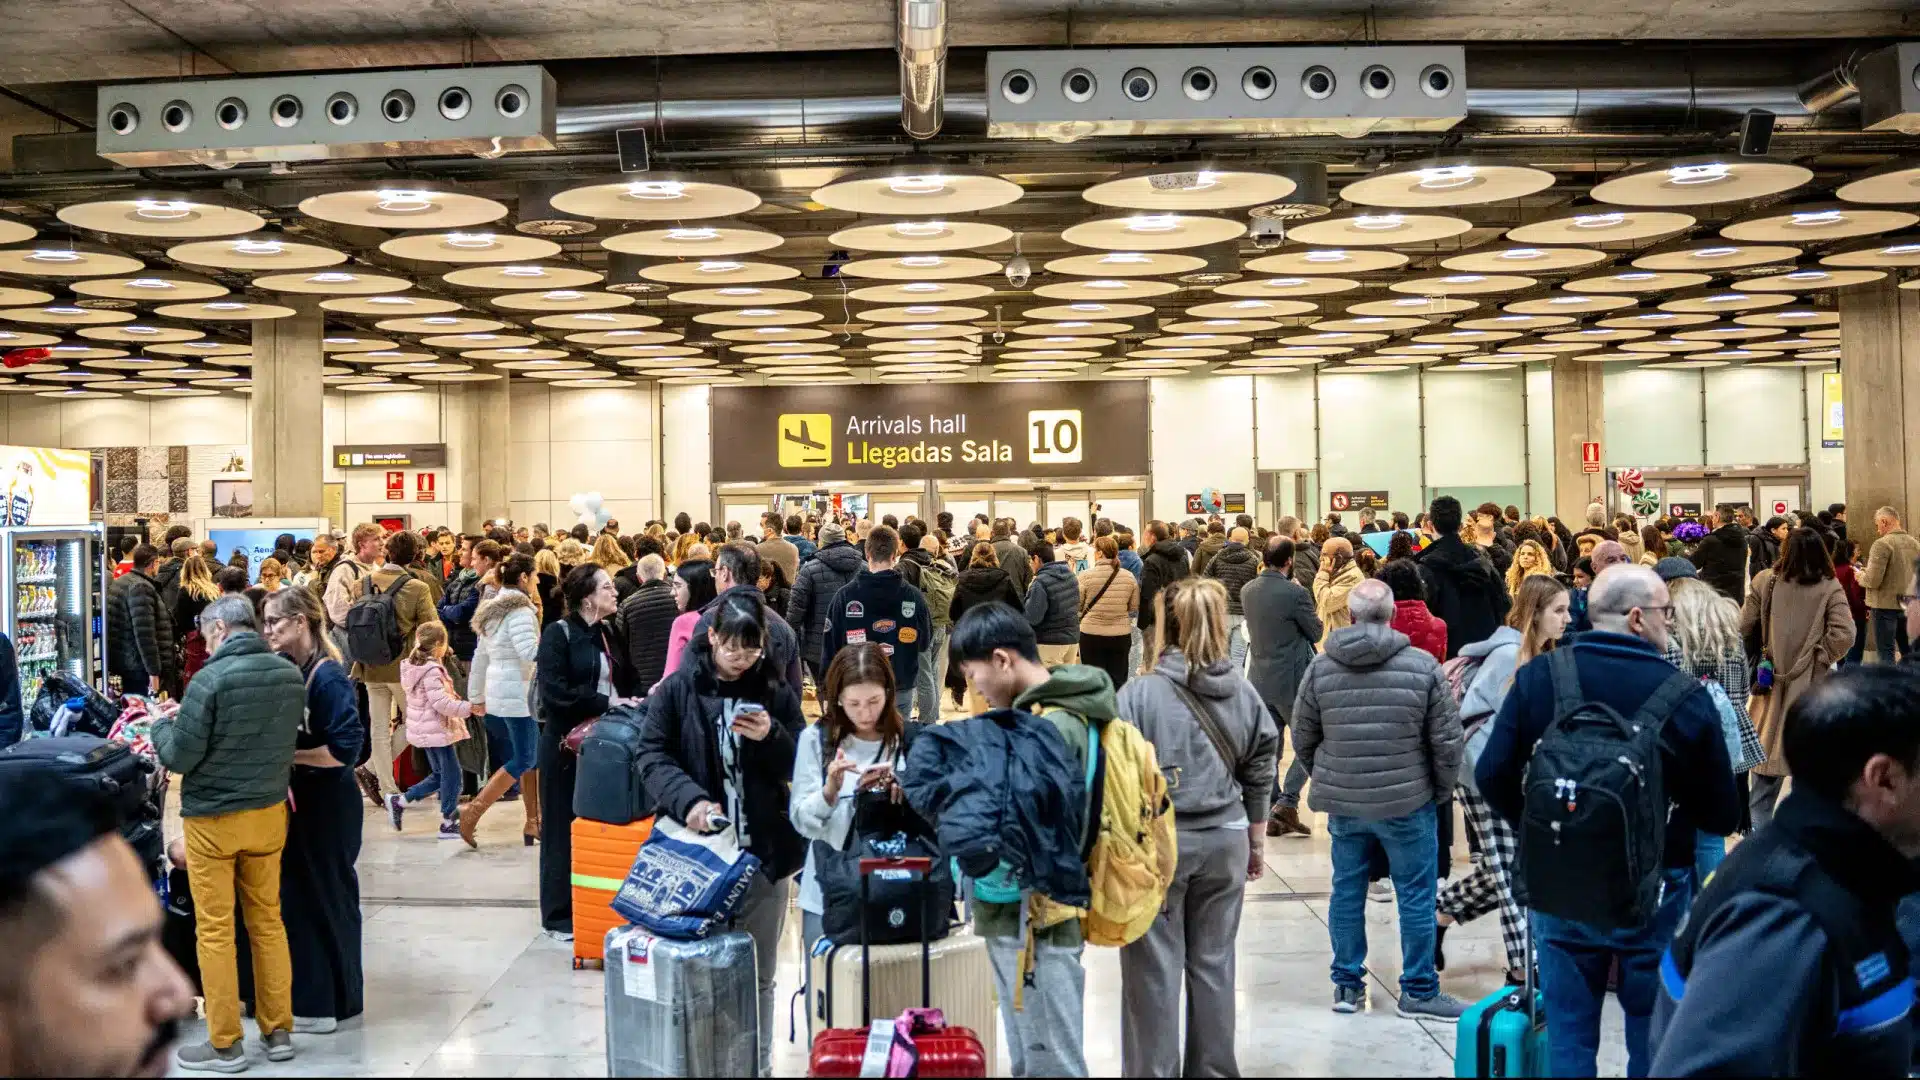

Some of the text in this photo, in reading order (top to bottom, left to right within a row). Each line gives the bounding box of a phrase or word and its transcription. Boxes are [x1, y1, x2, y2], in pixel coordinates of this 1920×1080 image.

[846, 413, 966, 435] Arrivals hall
[1032, 419, 1078, 454] 10
[847, 439, 1013, 469] Llegadas Sala
[723, 863, 757, 911] DAUNT
